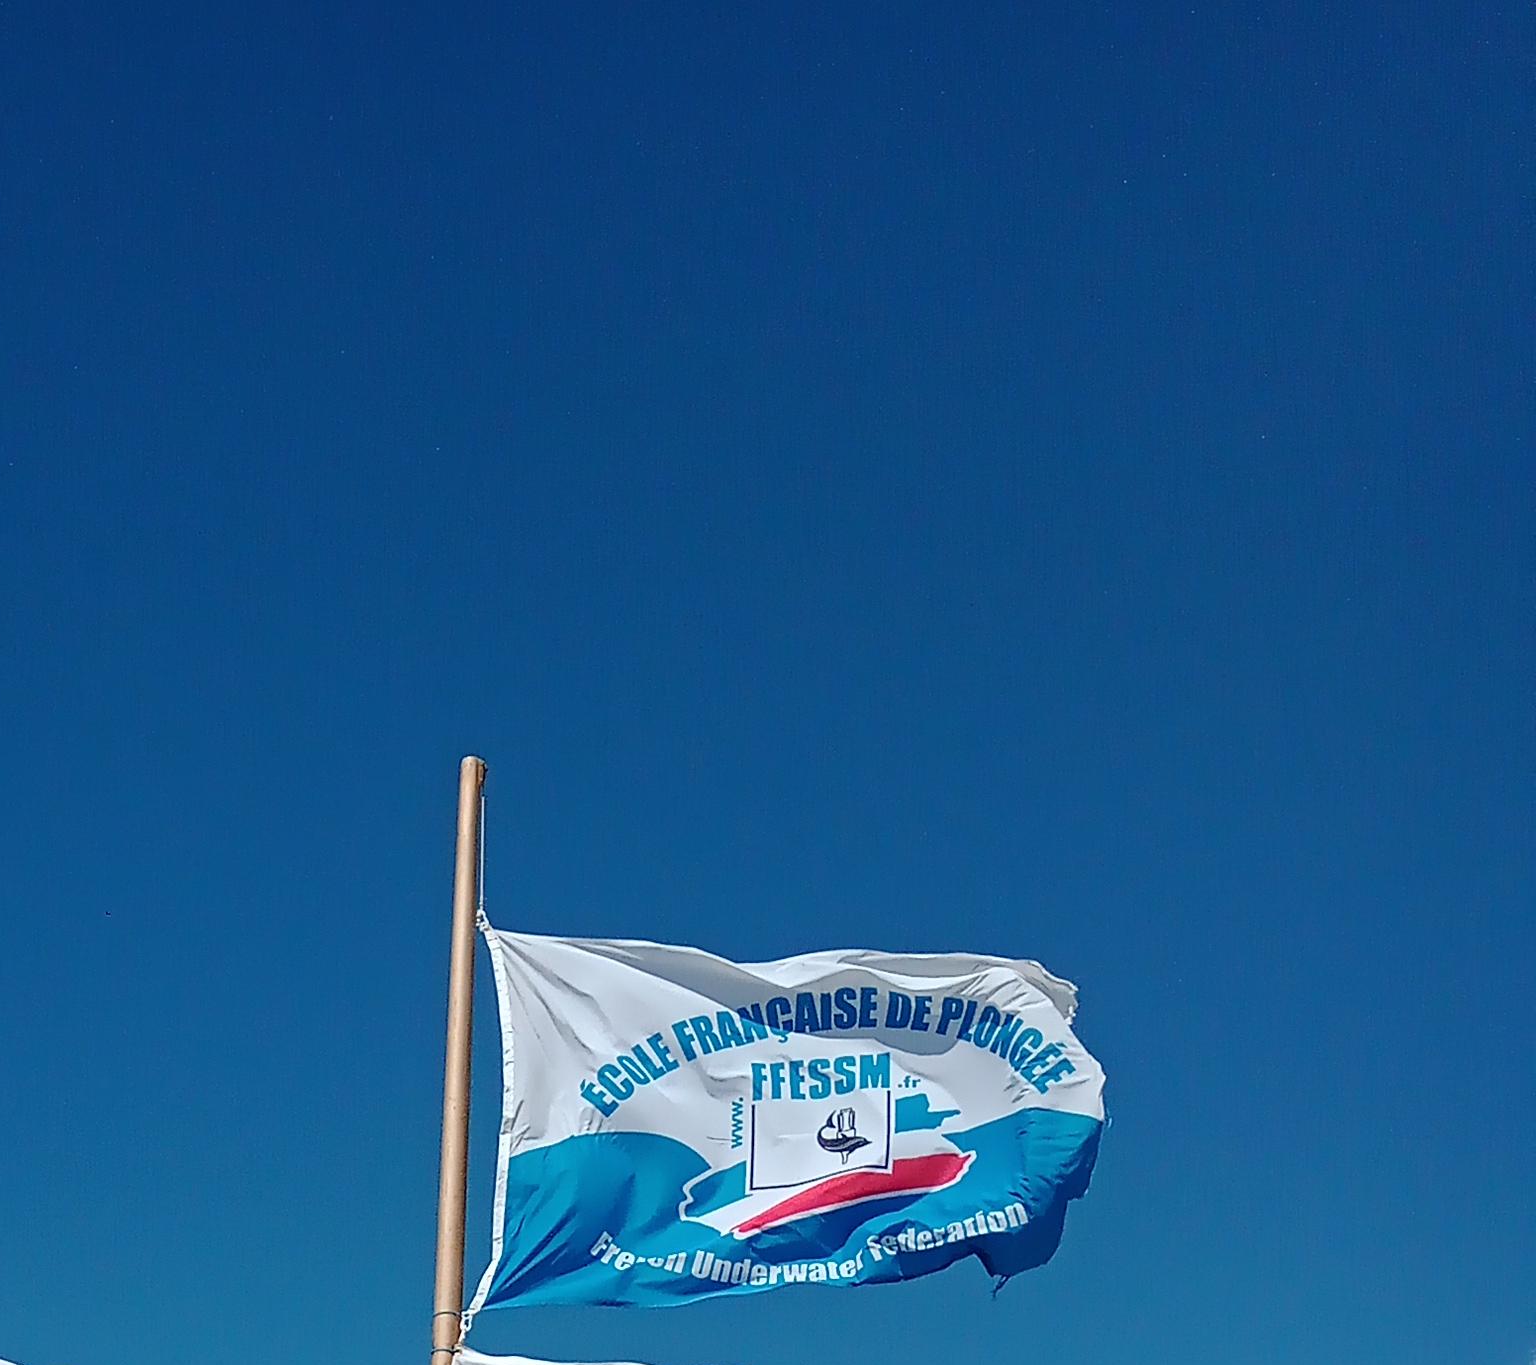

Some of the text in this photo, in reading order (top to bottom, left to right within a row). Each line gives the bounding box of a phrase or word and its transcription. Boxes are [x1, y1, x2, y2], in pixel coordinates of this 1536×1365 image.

[580, 987, 1076, 1118] ÉCOLE FRANÇAISE DE PLONGÉE
[751, 1052, 891, 1102] FFESSM
[897, 1075, 921, 1088] .fr
[731, 1097, 745, 1149] www.
[690, 1249, 864, 1287] Underwater
